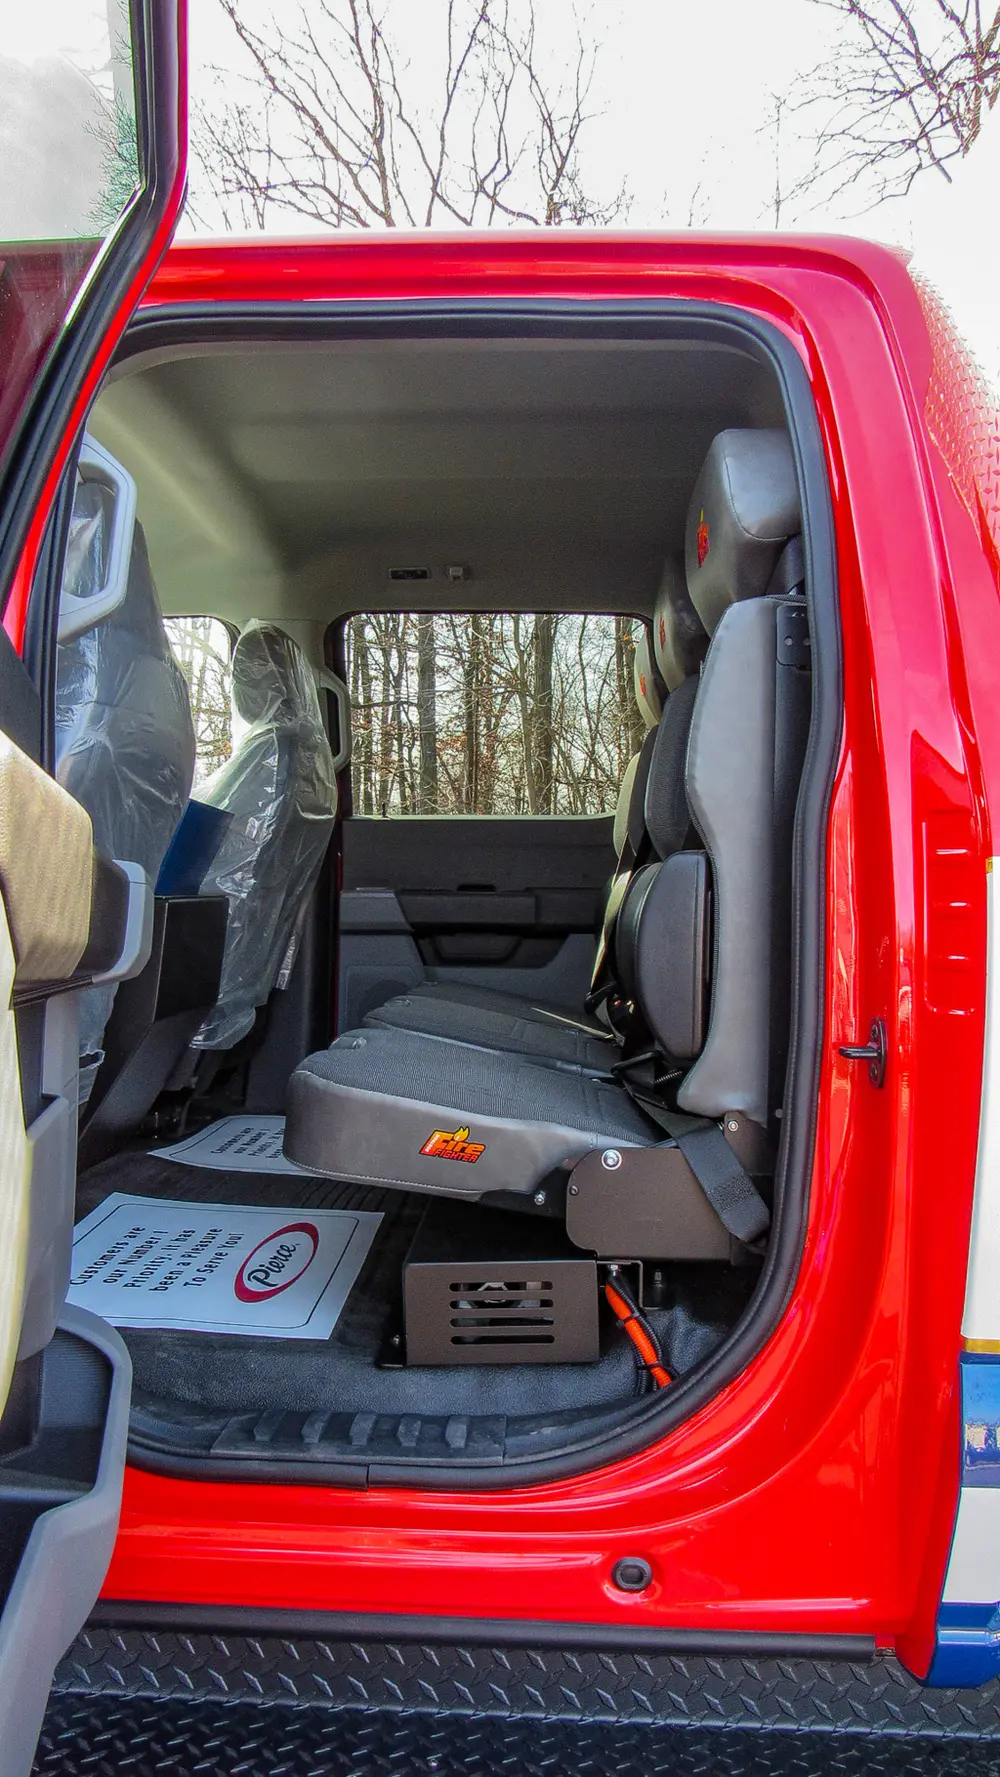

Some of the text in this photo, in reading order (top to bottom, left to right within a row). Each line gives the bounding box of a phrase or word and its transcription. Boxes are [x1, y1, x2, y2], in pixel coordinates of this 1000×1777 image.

[433, 1148, 479, 1163] FIGHTER
[69, 1226, 146, 1285] Customers are
[160, 1243, 182, 1251] It
[170, 1229, 196, 1242] has
[102, 1268, 128, 1284] our
[117, 1236, 162, 1266] Number
[147, 1270, 185, 1292] been
[180, 1227, 223, 1259] Pleasure
[182, 1232, 245, 1287] To Serve You!
[247, 1244, 297, 1288] Pierce
